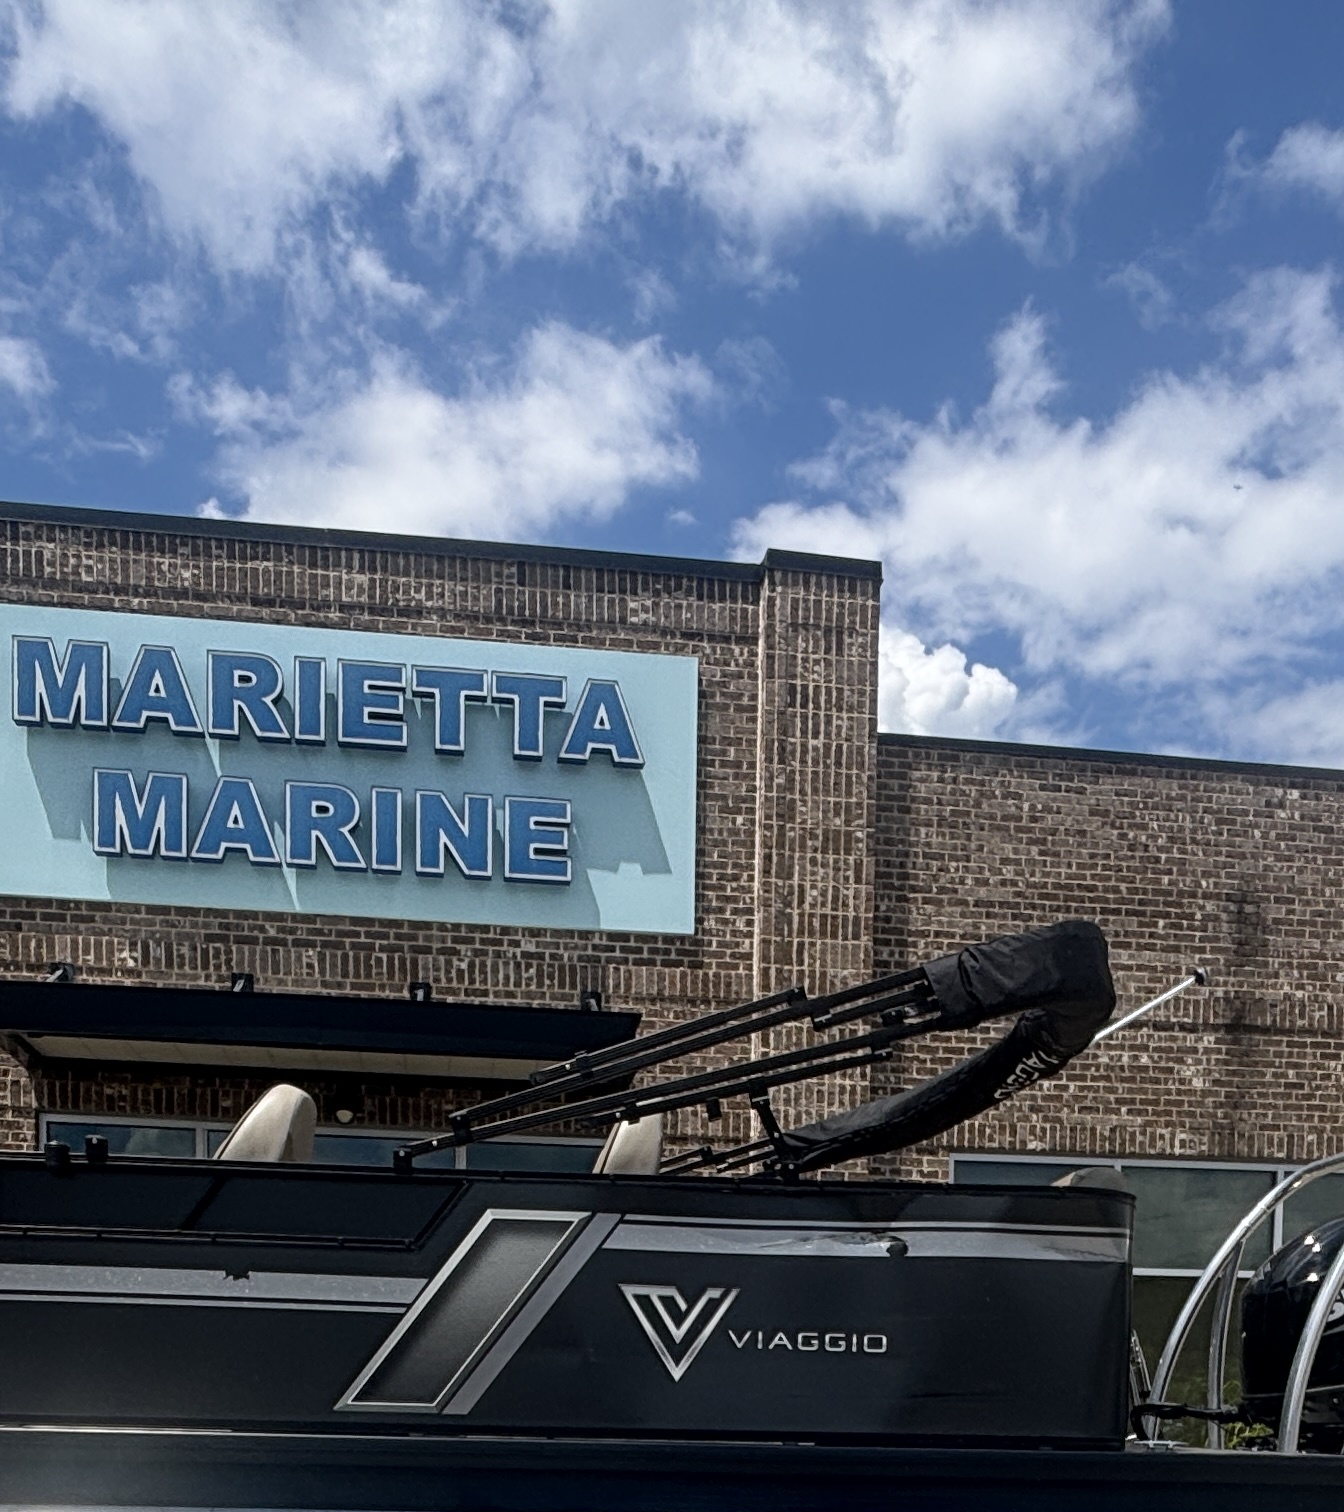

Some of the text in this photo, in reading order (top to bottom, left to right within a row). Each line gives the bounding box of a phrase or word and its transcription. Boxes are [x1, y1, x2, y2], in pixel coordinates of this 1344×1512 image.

[11, 634, 645, 769] MARIETTA
[92, 766, 572, 885] MARINE
[728, 1329, 888, 1353] VIAGGIO
